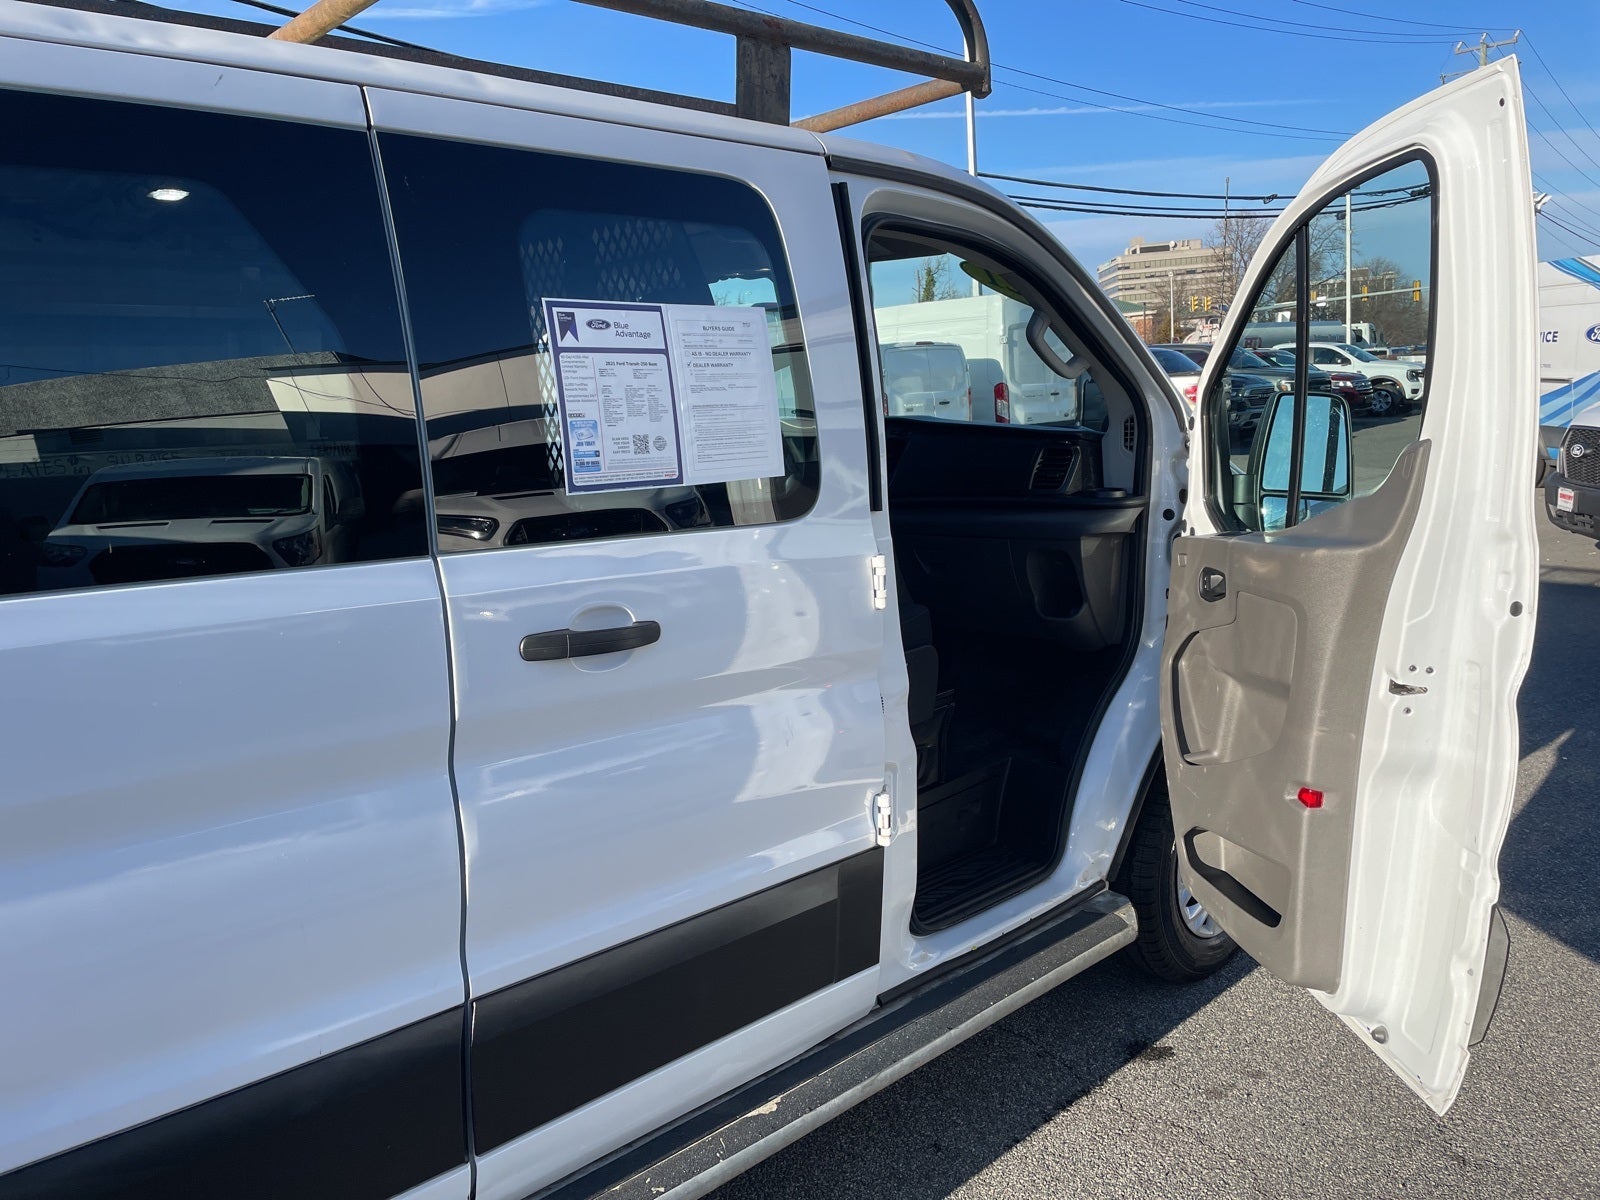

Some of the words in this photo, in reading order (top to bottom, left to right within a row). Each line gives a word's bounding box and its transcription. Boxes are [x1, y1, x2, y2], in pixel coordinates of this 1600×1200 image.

[589, 320, 608, 329] Ford
[613, 321, 629, 329] Blue
[615, 330, 651, 340] Advantage
